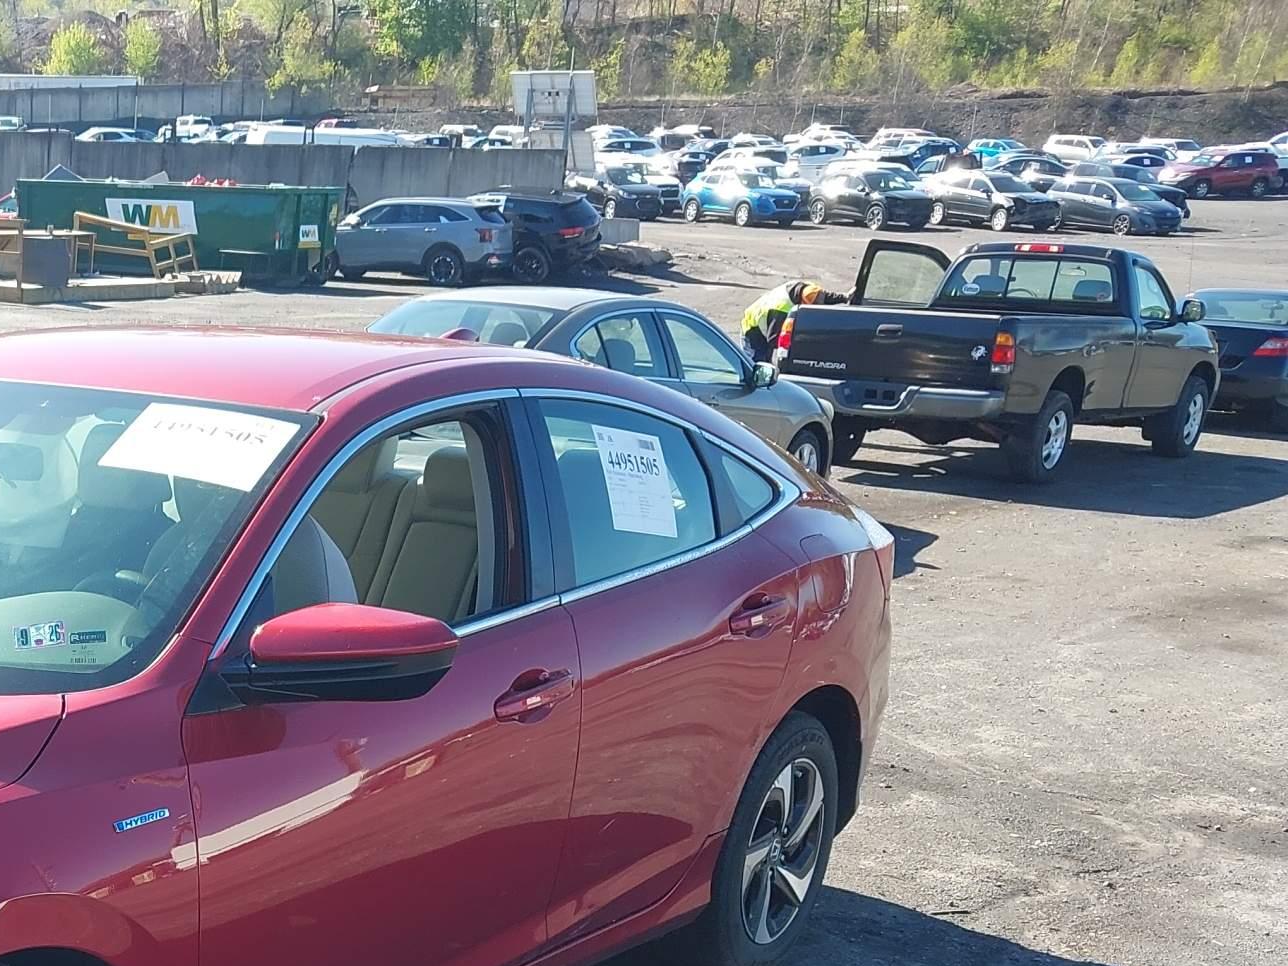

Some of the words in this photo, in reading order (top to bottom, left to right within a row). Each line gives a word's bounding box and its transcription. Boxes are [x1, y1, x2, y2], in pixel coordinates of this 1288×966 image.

[121, 203, 180, 228] WM
[302, 228, 316, 239] WM
[808, 360, 847, 369] TUNDRA
[607, 449, 660, 476] 44951505
[20, 628, 29, 646] 9
[48, 624, 61, 642] 26
[124, 810, 167, 829] HYBRID
